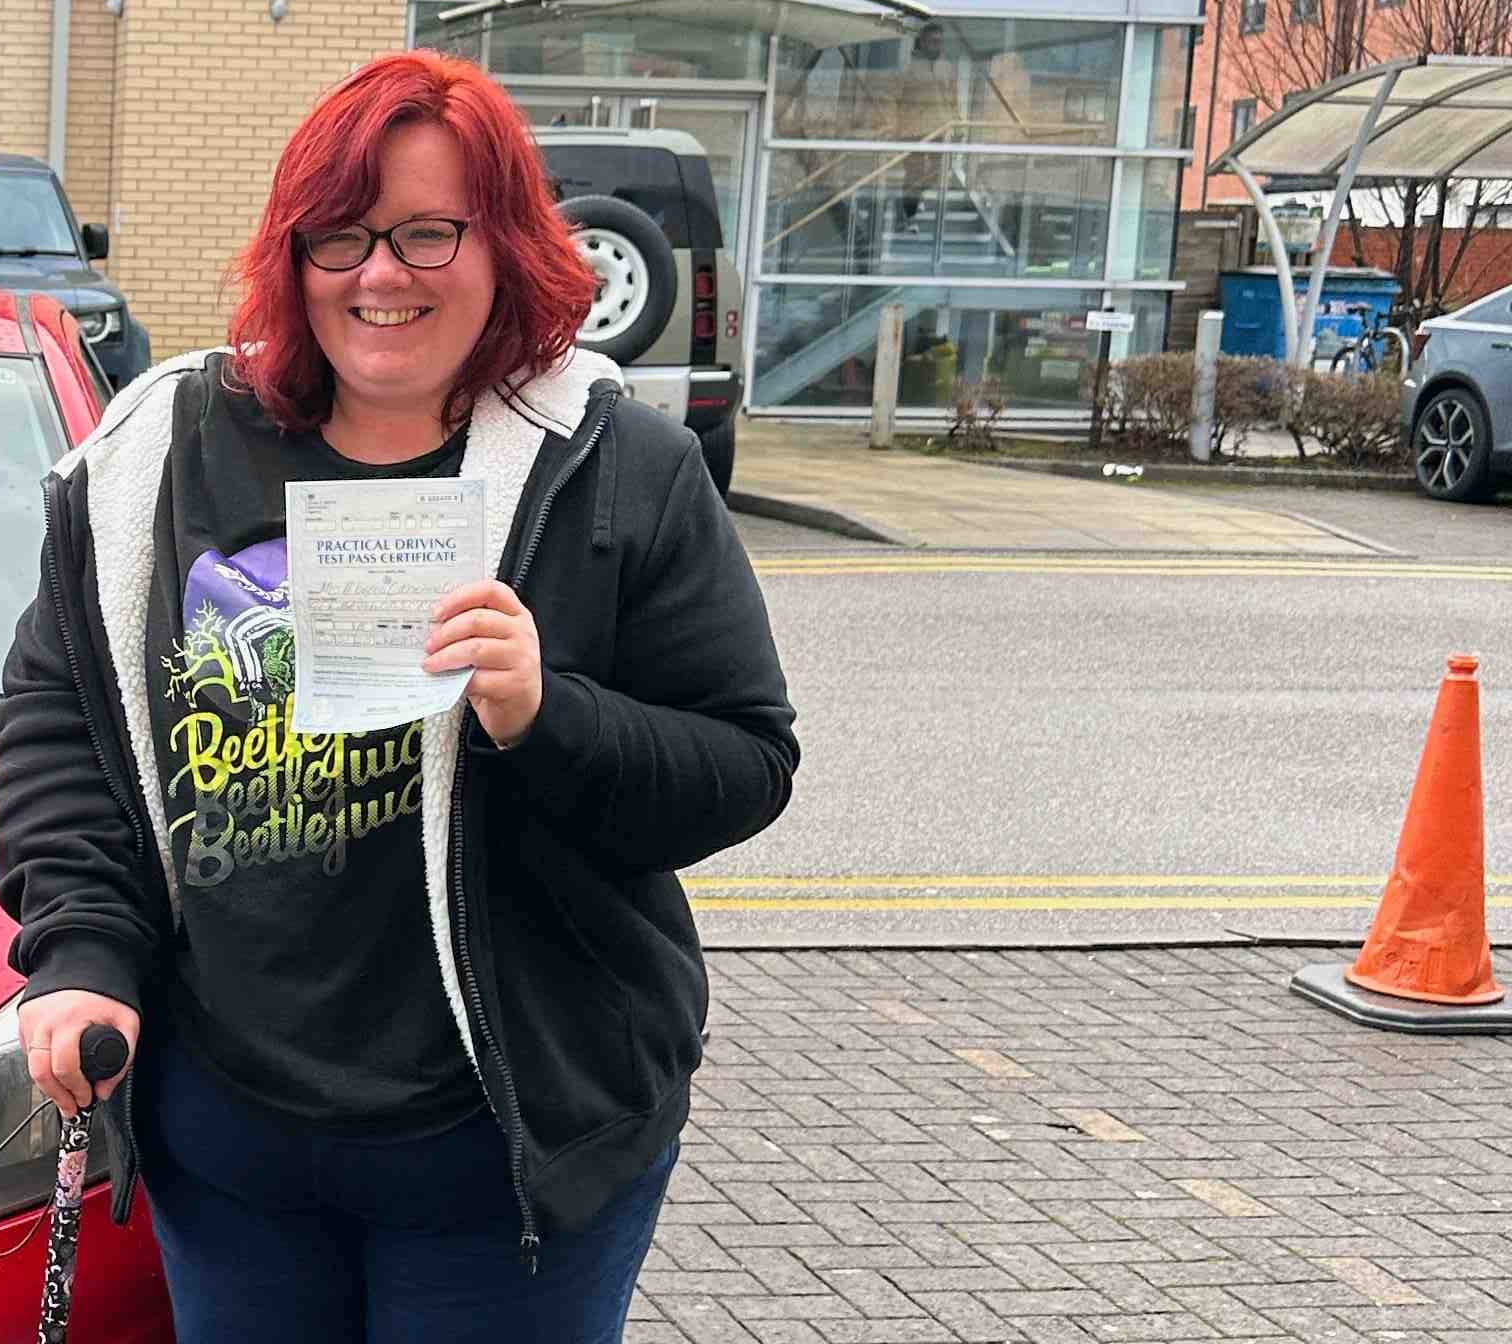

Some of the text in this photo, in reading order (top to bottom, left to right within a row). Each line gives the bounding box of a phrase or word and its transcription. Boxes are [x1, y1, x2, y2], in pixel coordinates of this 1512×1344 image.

[316, 537, 457, 552] PRACTICAL DRIVING
[318, 551, 457, 565] TEST PASS CERTIFICATE
